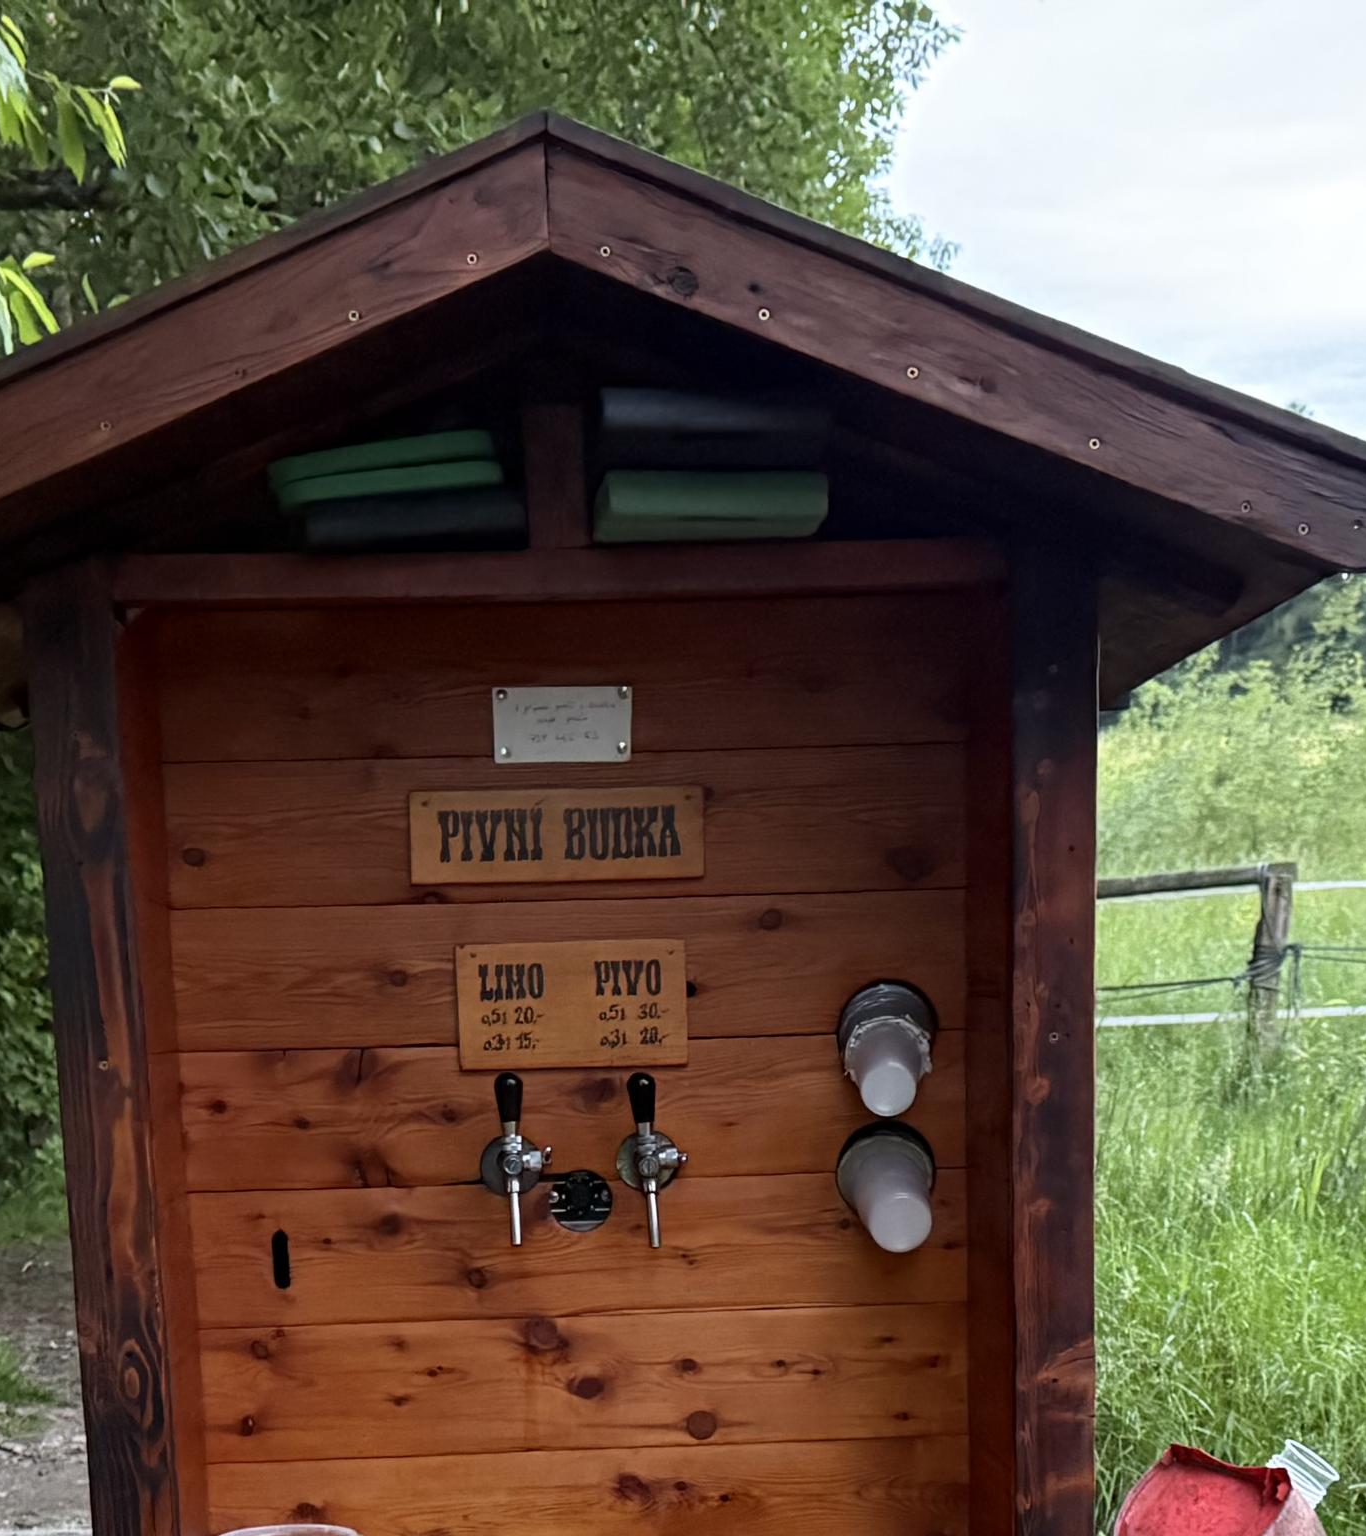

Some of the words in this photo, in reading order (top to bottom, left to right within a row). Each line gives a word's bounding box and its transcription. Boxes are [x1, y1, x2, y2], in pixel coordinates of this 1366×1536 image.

[563, 804, 682, 860] BUDKA
[478, 963, 544, 1002] LIMO
[594, 959, 661, 996] PIVO
